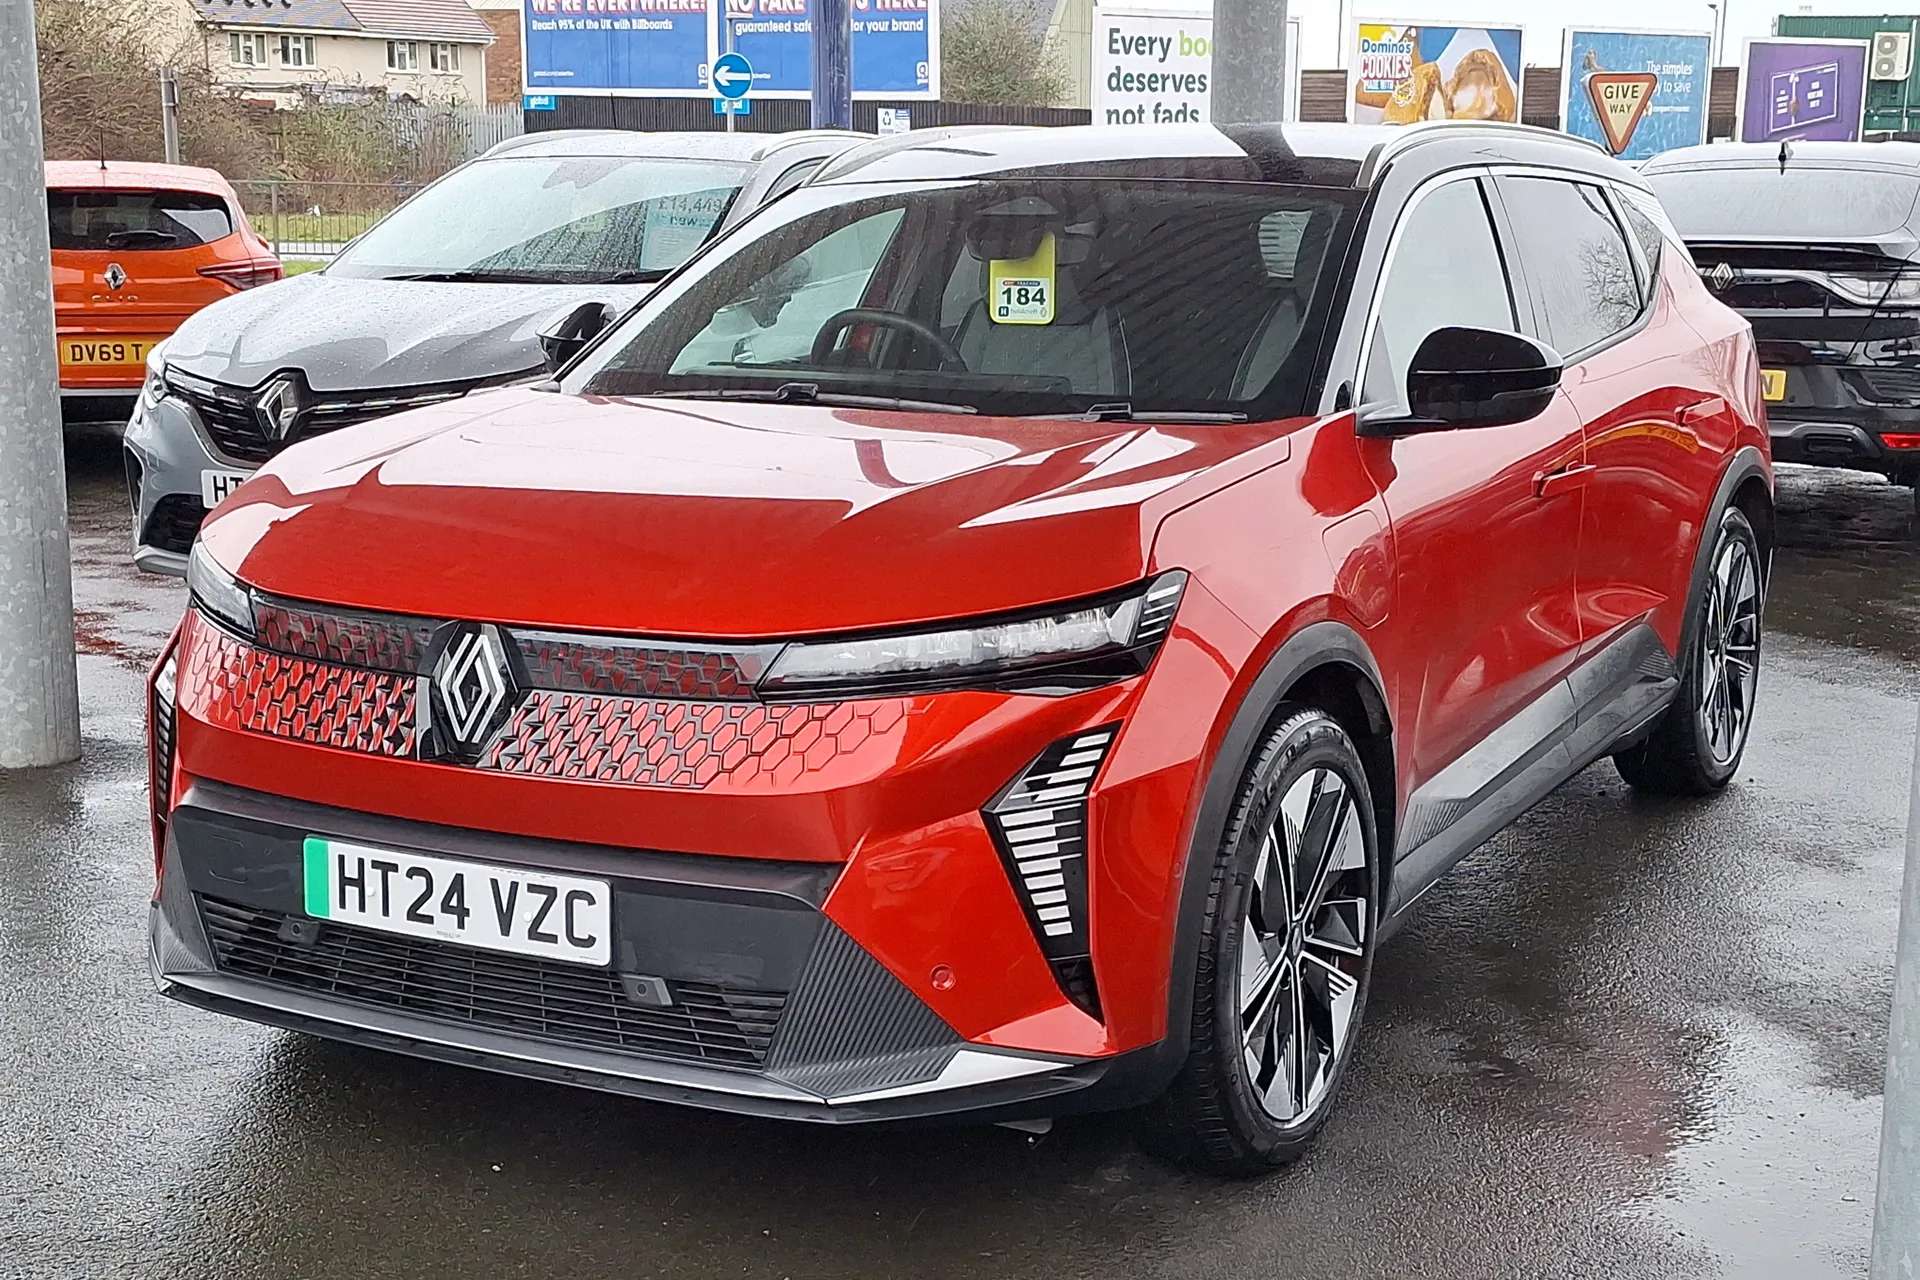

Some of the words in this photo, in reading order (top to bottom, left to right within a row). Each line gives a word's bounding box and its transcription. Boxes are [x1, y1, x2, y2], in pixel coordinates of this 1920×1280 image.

[532, 0, 581, 12] WERE
[531, 19, 557, 30] Reach
[576, 19, 585, 30] of
[585, 19, 600, 30] the
[600, 18, 612, 30] UK
[613, 18, 631, 30] with
[632, 18, 673, 30] Billboards
[735, 20, 792, 36] guaranteed
[866, 20, 889, 34] your
[892, 18, 924, 32] brand
[1108, 27, 1172, 63] Every
[1179, 30, 1215, 57] bo
[1361, 38, 1412, 54] Domino's
[1361, 55, 1412, 80] COOKIES
[1107, 65, 1207, 93] deserves
[1604, 84, 1639, 99] GIVE
[1105, 103, 1145, 125] not
[1153, 101, 1200, 124] fads
[1609, 103, 1632, 114] WAY
[1001, 287, 1046, 306] 184
[70, 343, 125, 362] DV69
[212, 475, 244, 502] HT
[337, 853, 470, 930] HT24
[489, 877, 597, 949] VZC
